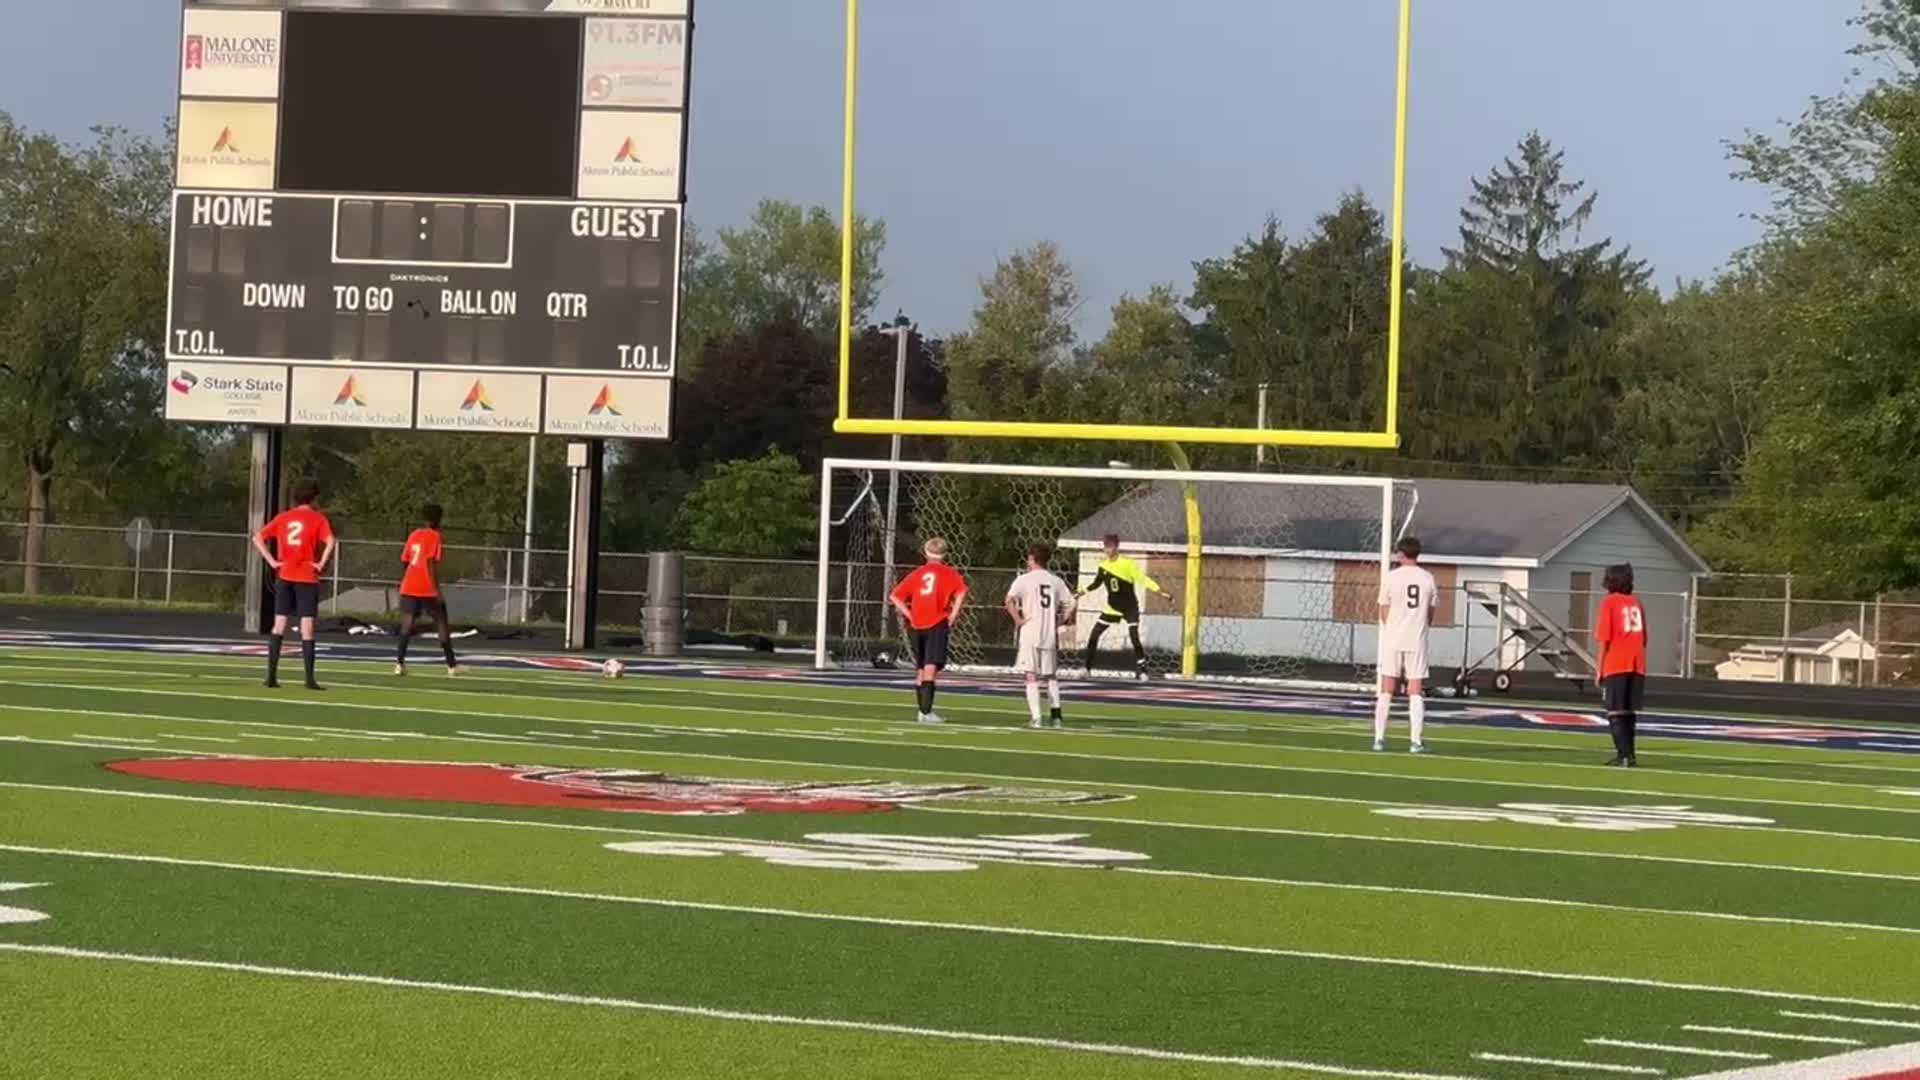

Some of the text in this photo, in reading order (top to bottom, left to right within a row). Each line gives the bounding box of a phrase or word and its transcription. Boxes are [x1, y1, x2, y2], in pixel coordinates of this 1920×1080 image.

[206, 36, 277, 52] MALONE
[204, 51, 276, 65] UNIVERSITY
[192, 196, 273, 227] HOME
[571, 207, 664, 238] GUEST
[243, 283, 306, 308] DOWN
[333, 286, 393, 311] TO GO
[440, 290, 517, 315] BALL ON
[547, 292, 588, 317] QTR
[175, 329, 225, 355] T.O.L.
[617, 345, 669, 370] T.O.L.
[203, 376, 284, 392] Stark State
[287, 520, 304, 547] 2
[410, 543, 422, 567] 7
[920, 572, 936, 596] 3
[1039, 584, 1052, 609] 5
[1406, 583, 1421, 609] 9
[1621, 606, 1643, 633] 19
